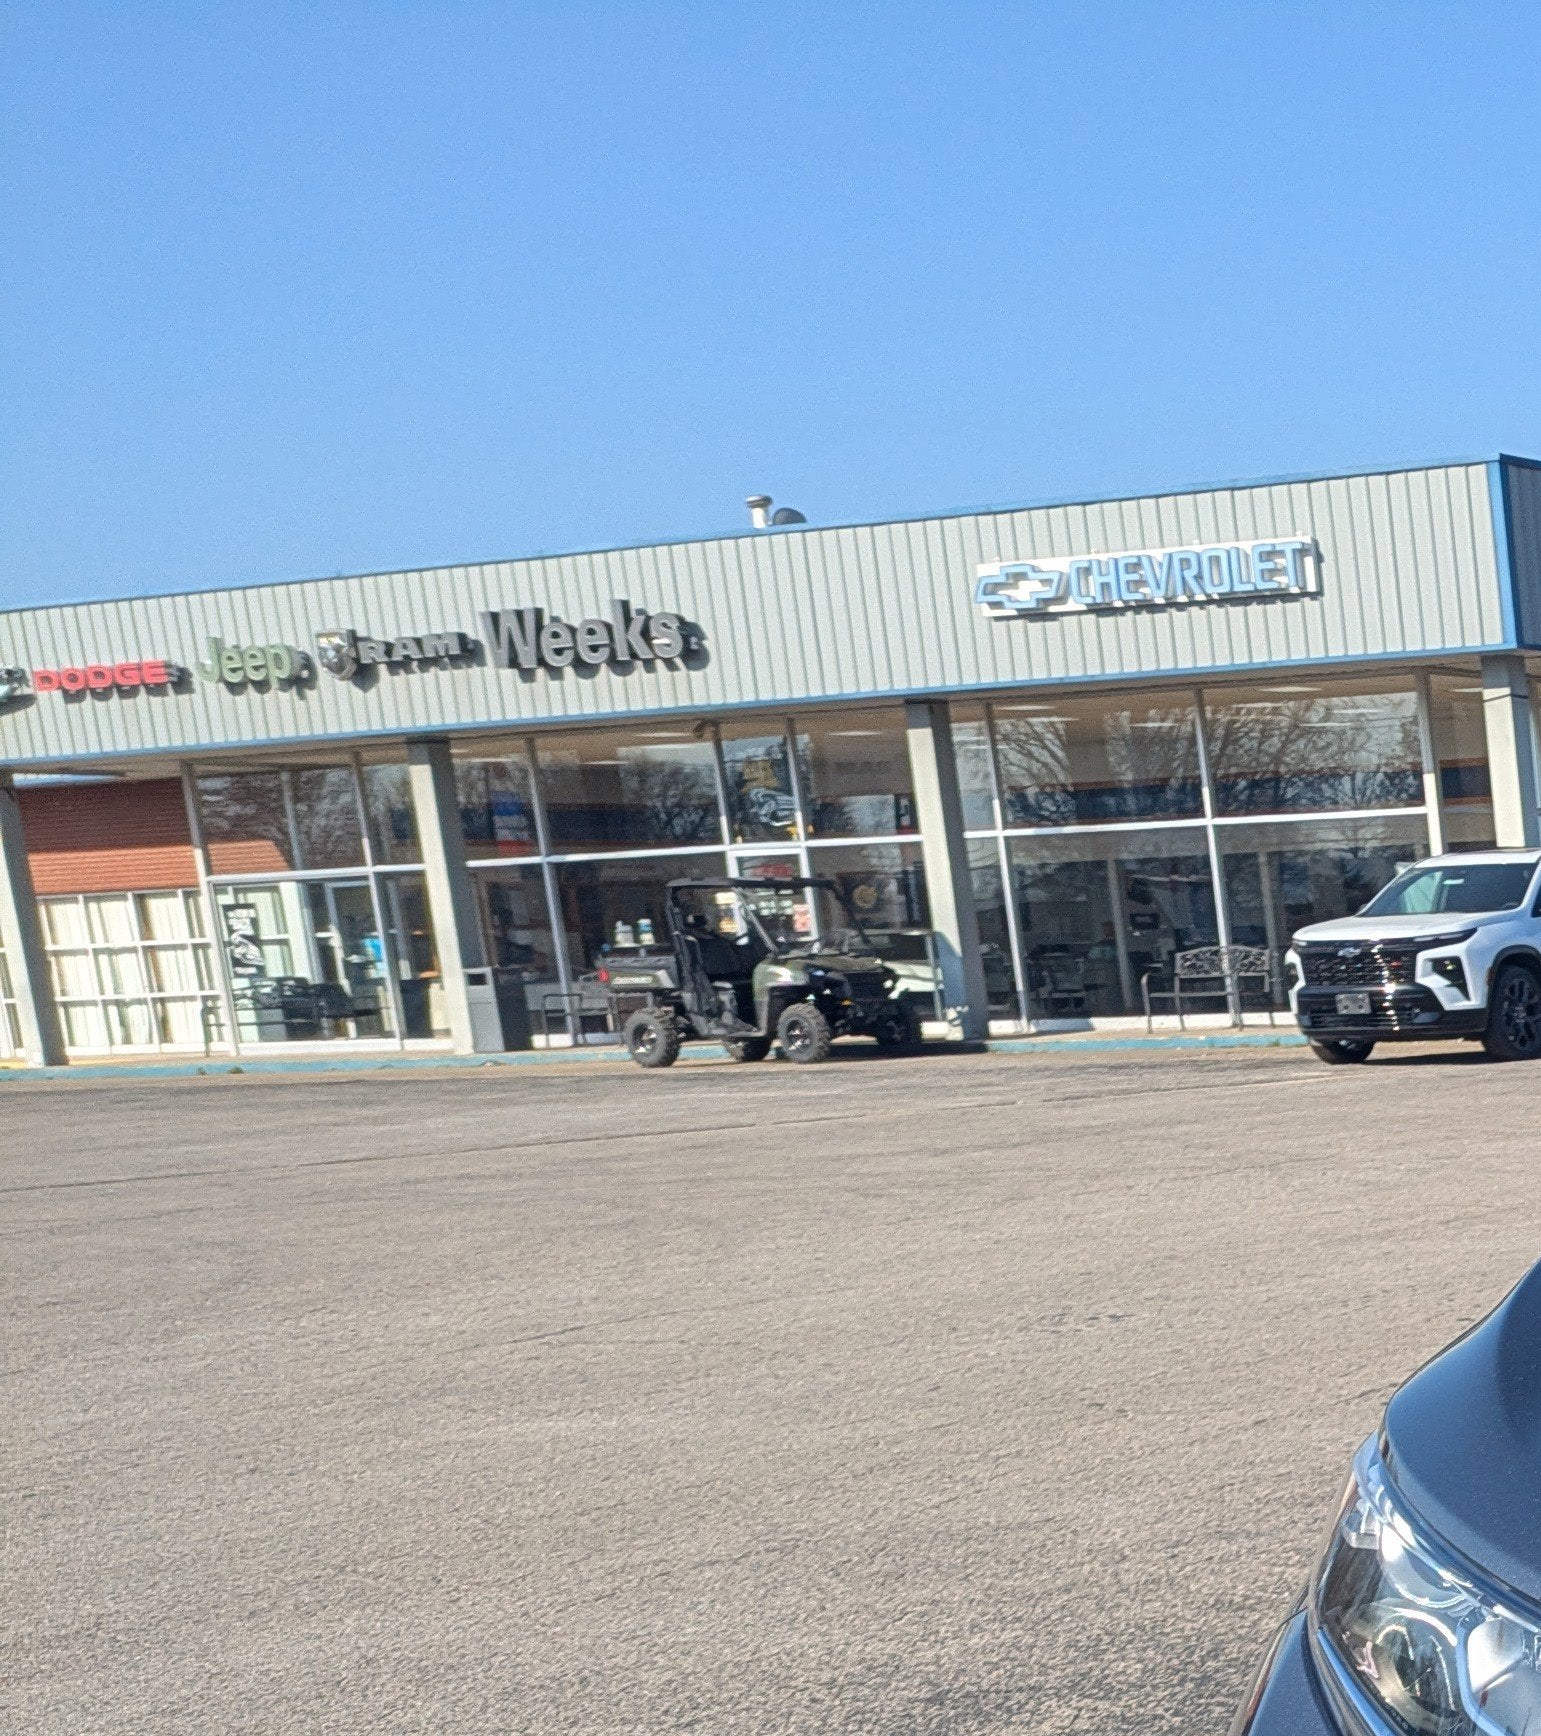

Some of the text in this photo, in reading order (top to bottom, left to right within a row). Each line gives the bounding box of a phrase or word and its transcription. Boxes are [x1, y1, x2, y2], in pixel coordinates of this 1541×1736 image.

[1069, 542, 1304, 604] CHEVROLET
[33, 600, 684, 692] DODGE Jeep RAM Weeks
